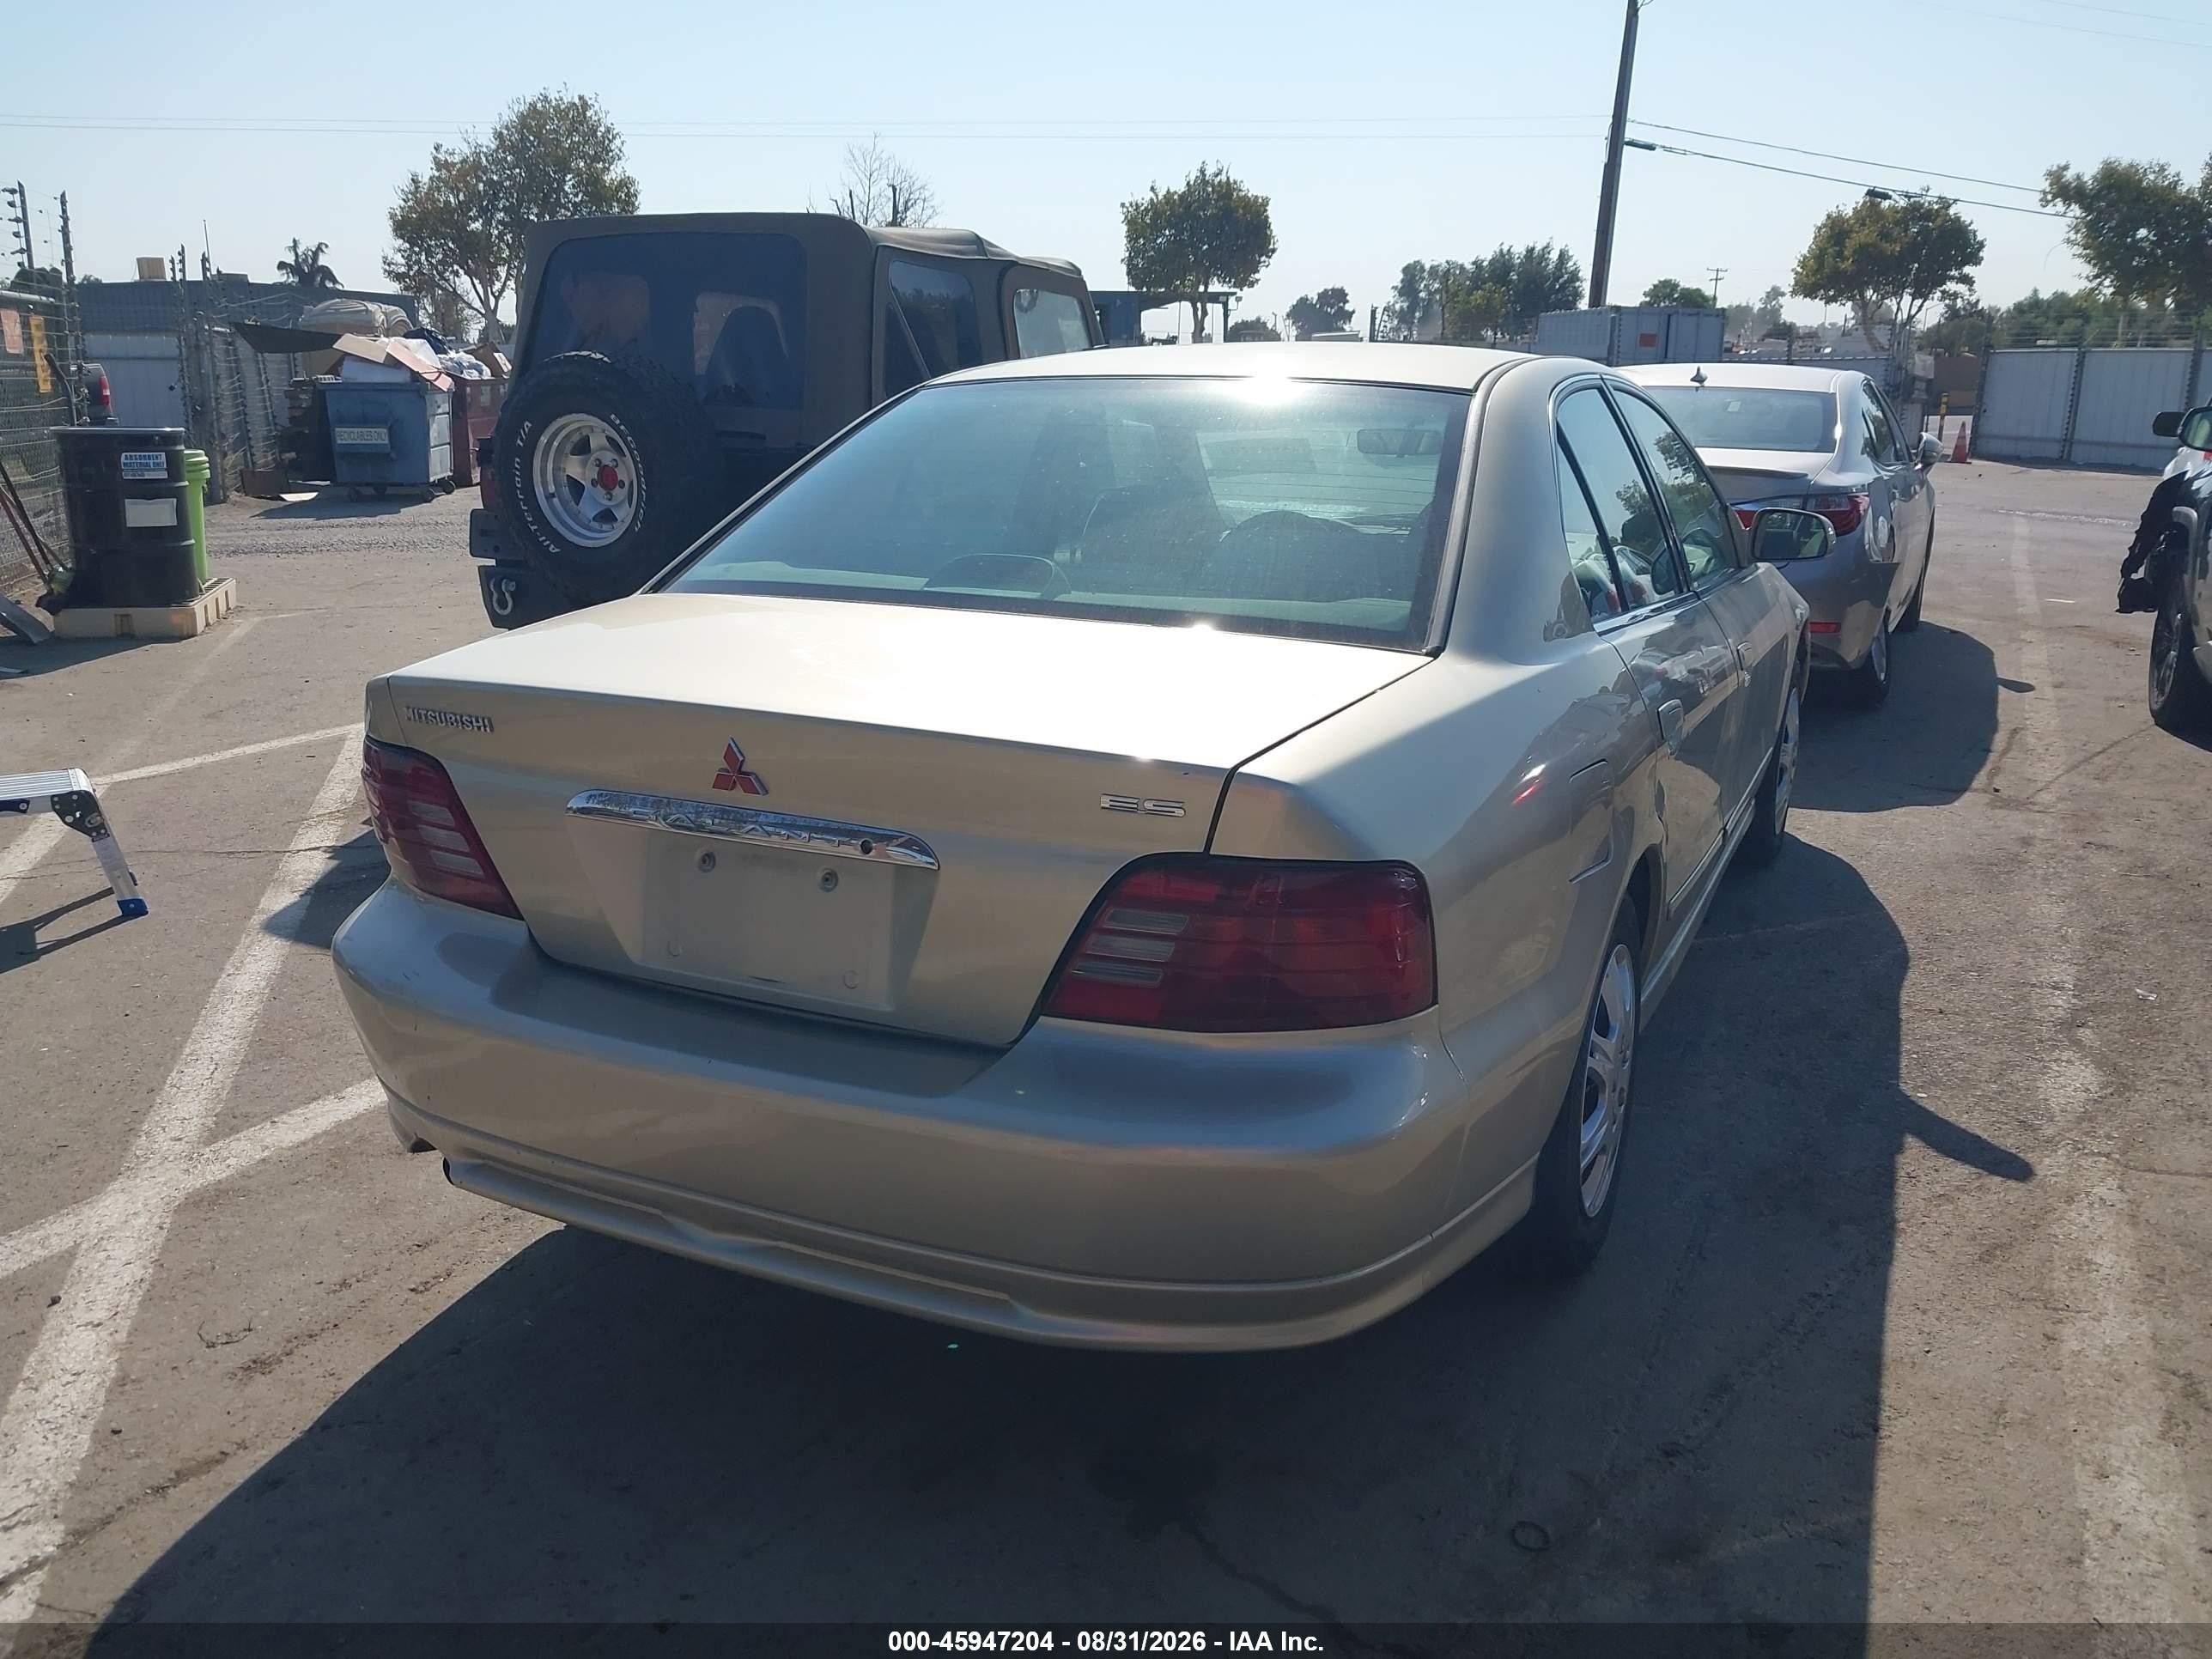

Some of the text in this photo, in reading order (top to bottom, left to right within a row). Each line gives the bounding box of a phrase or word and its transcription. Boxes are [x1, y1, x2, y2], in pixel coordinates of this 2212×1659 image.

[513, 420, 562, 553] All-Terrain T/A
[404, 706, 495, 733] MITSUBISHI
[1100, 793, 1187, 817] ES
